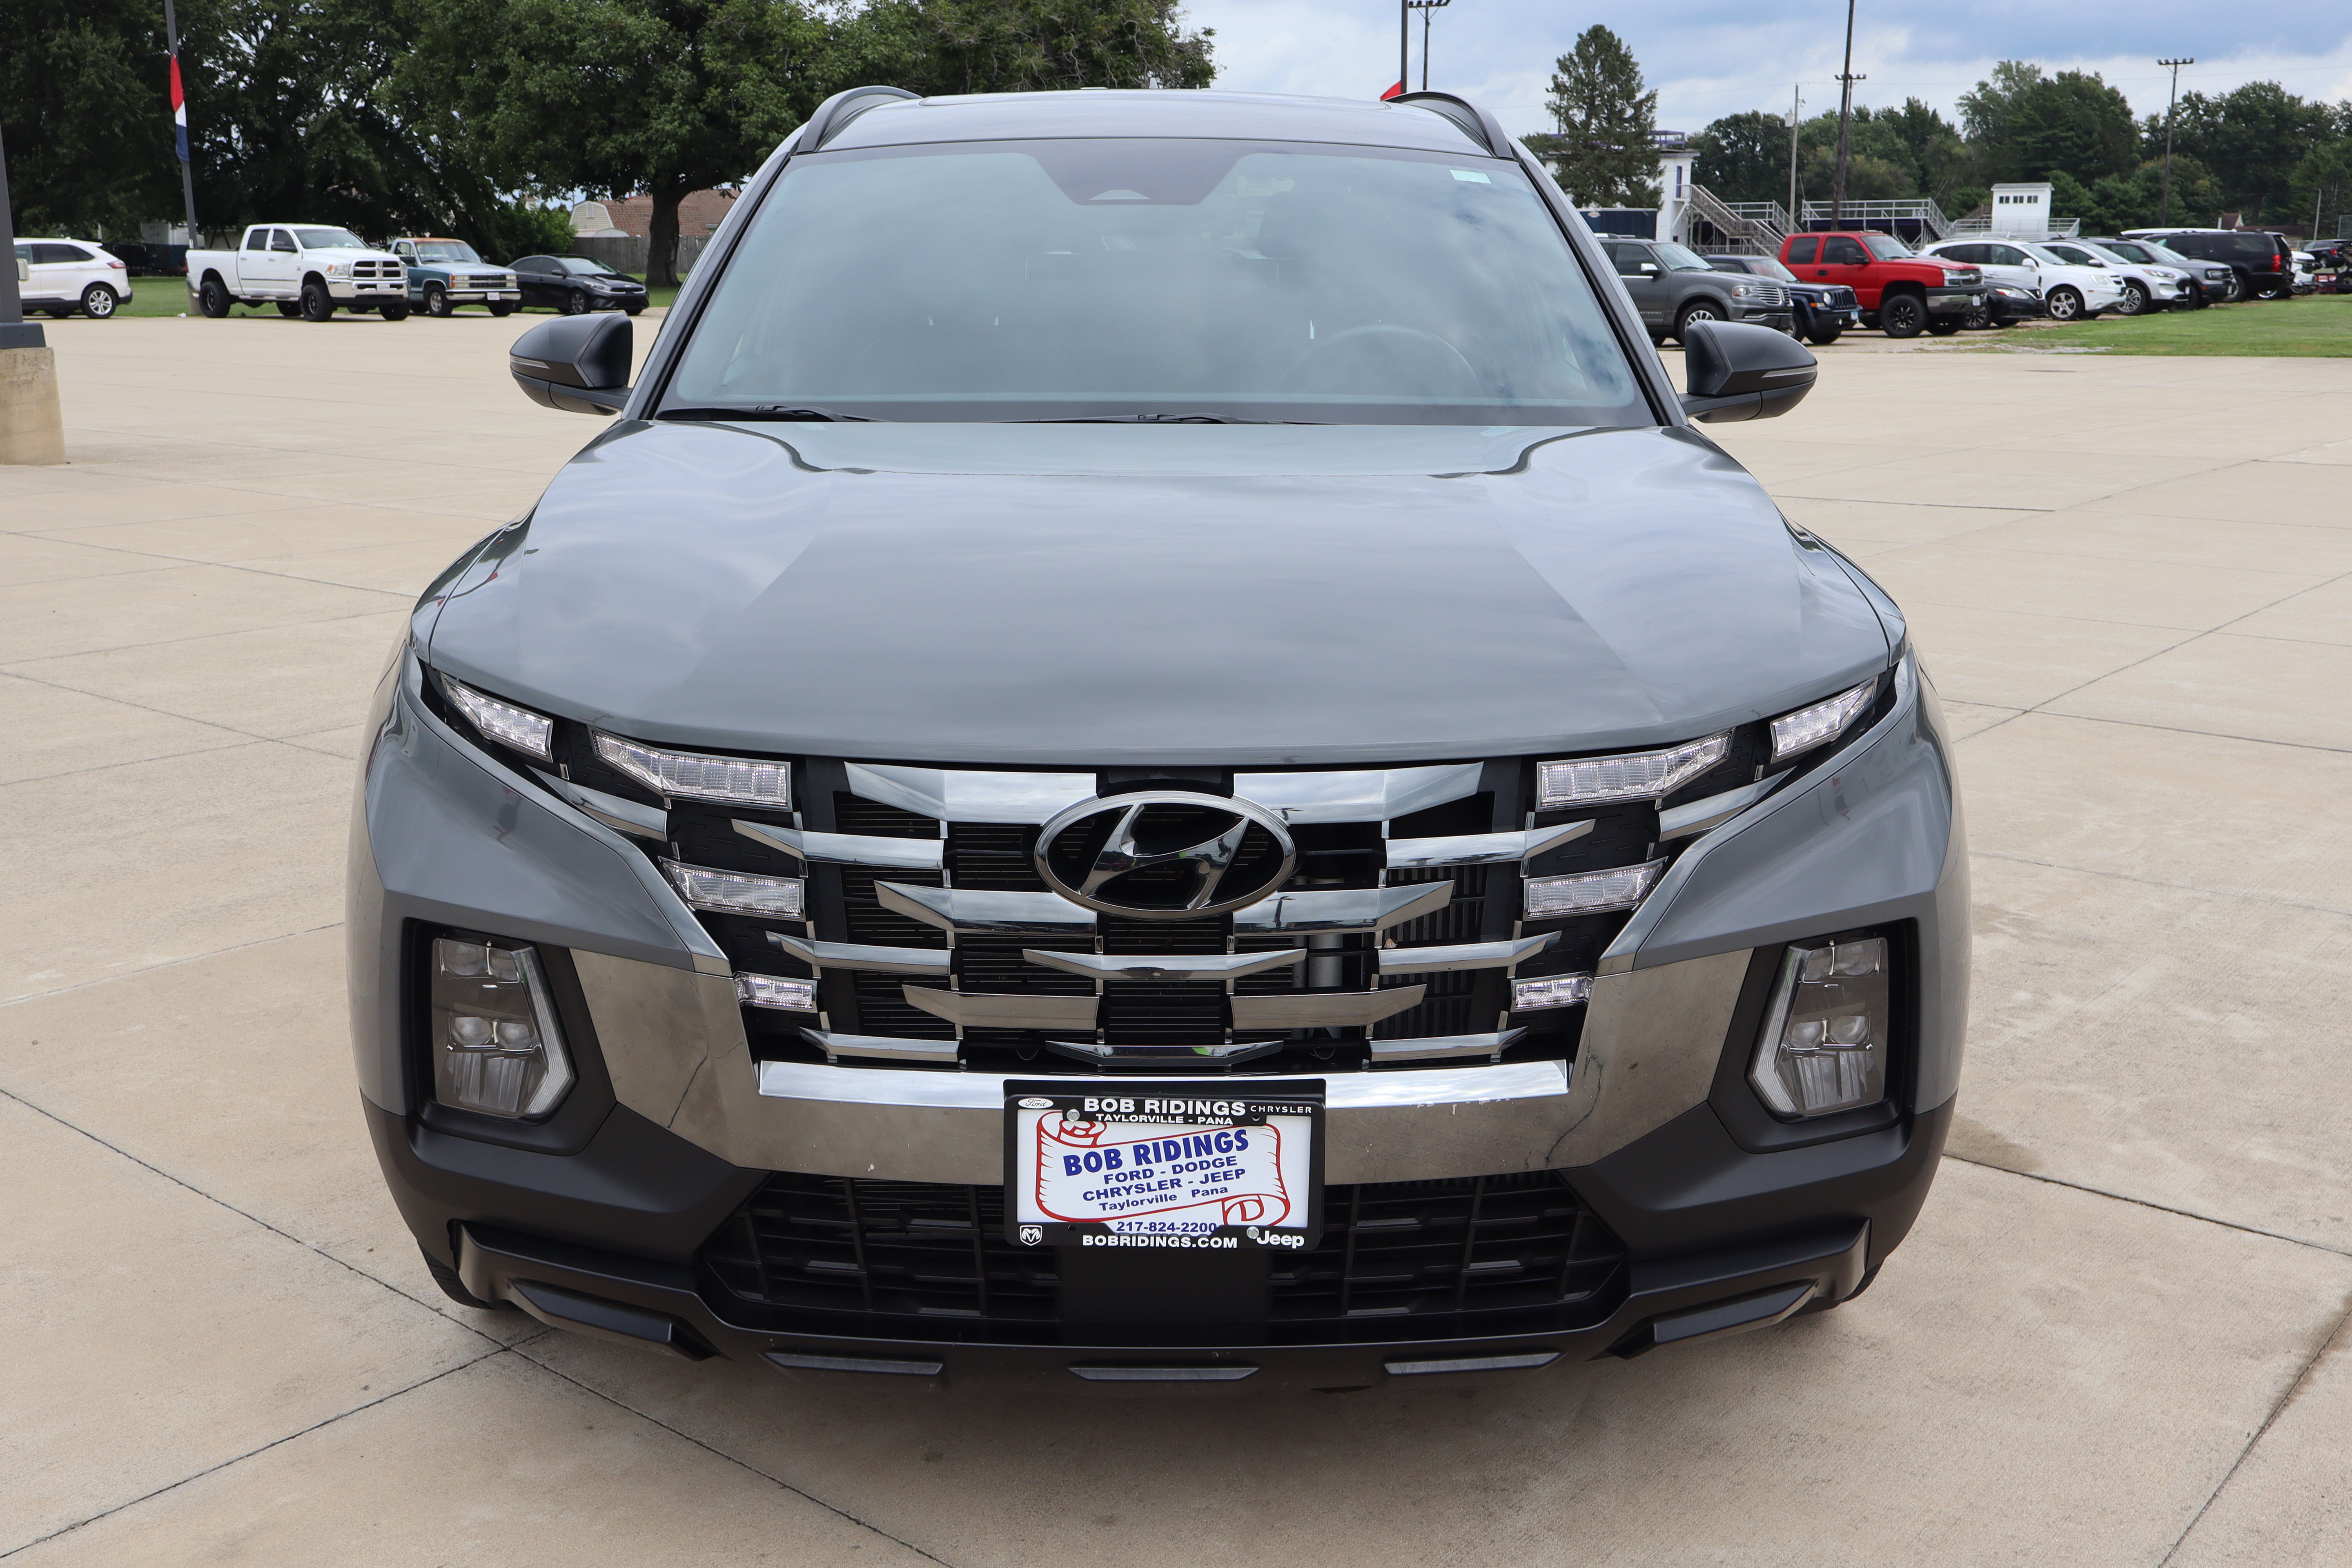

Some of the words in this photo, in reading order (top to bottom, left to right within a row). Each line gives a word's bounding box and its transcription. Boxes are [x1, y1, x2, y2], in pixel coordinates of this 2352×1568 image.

[1025, 1099, 1047, 1107] Ford
[1084, 1098, 1135, 1113] BOB
[1145, 1099, 1246, 1116] RIDINGS
[1250, 1105, 1312, 1114] CHRYSLER
[1096, 1114, 1184, 1123] TAYLORVILLE
[1197, 1116, 1233, 1125] PANA
[1063, 1148, 1123, 1176] BOB
[1133, 1129, 1249, 1166] RIDINGS
[1103, 1168, 1154, 1185] FORD
[1172, 1155, 1238, 1175] DODGE
[1082, 1178, 1183, 1201] CHRYSLER
[1199, 1168, 1246, 1185] JEEP
[1098, 1194, 1178, 1211] Taylorville
[1191, 1186, 1228, 1198] Pana
[1116, 1221, 1217, 1232] 217-824-2200
[1082, 1234, 1237, 1248] BOBRIDINGS.COM
[1256, 1230, 1305, 1249] Jeep
